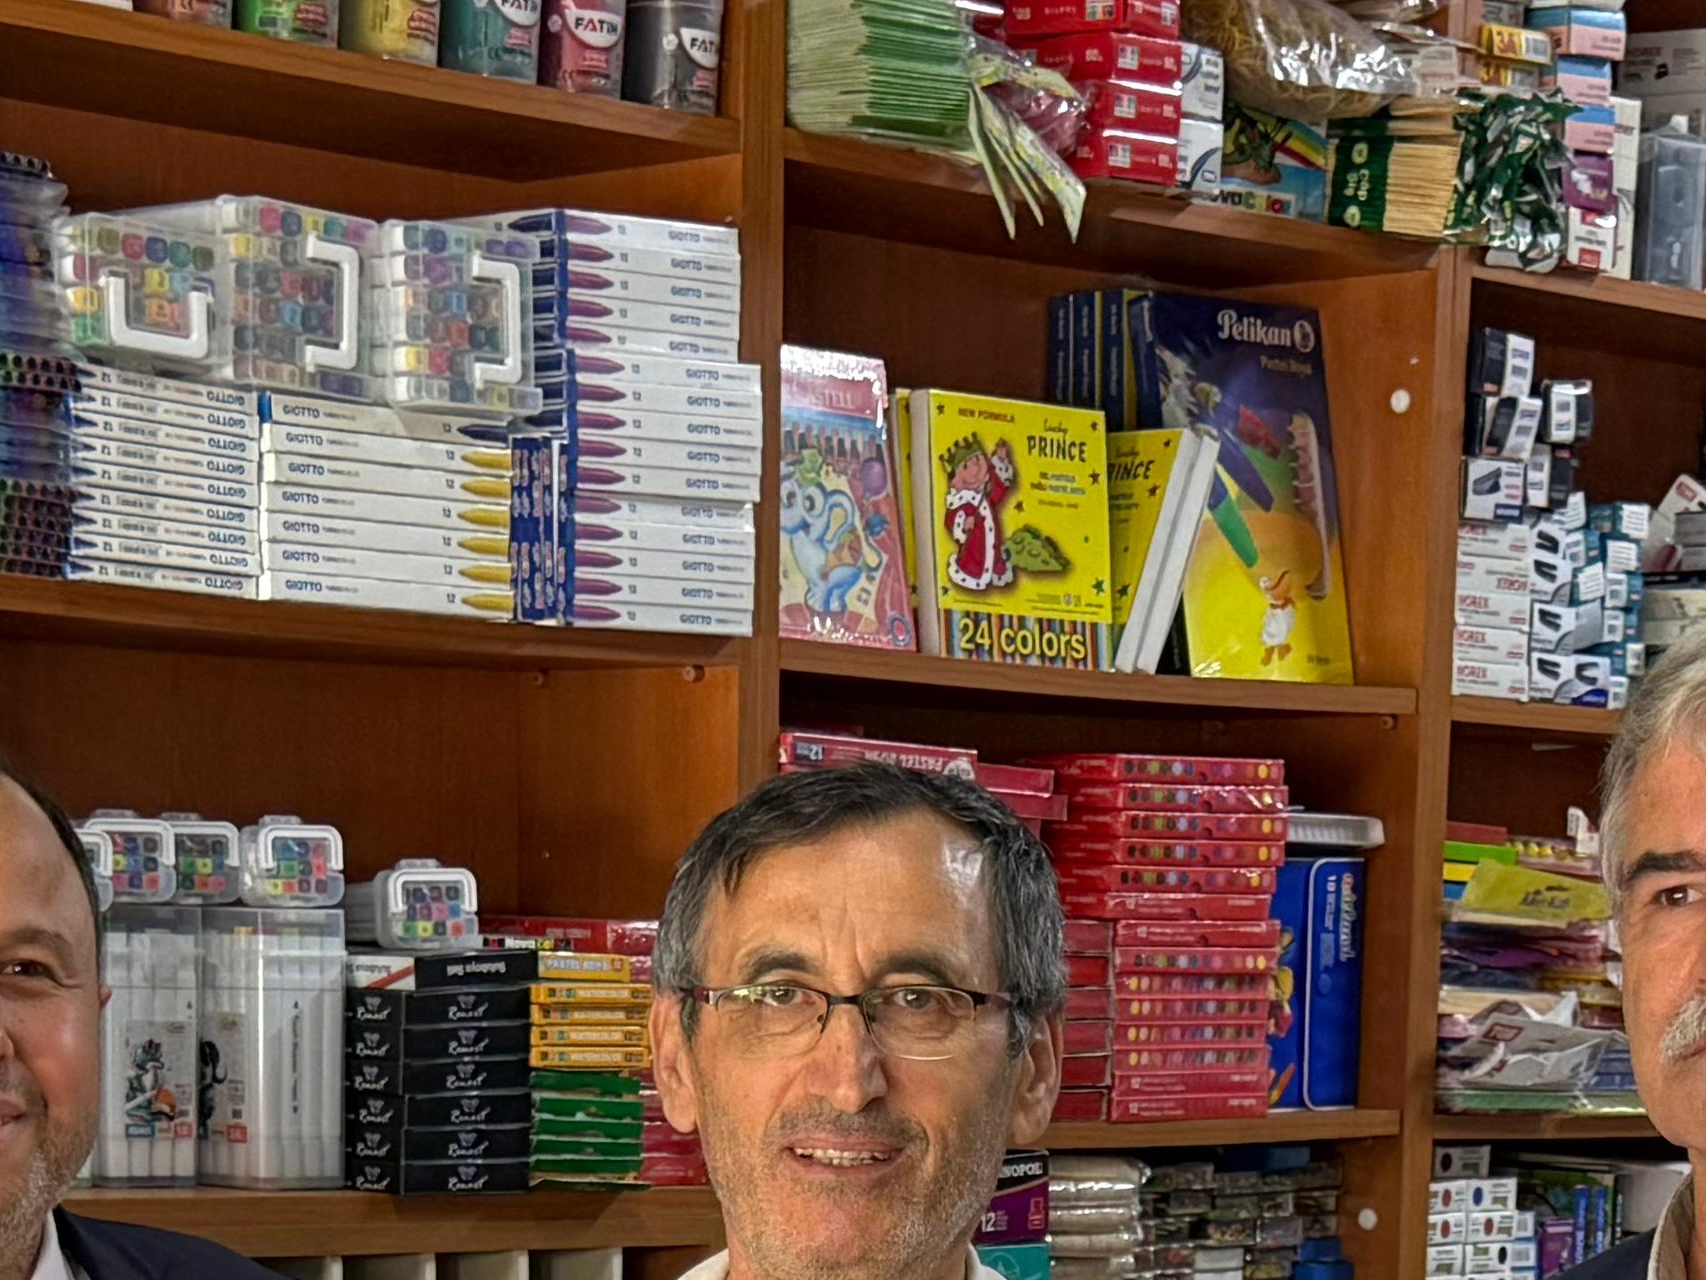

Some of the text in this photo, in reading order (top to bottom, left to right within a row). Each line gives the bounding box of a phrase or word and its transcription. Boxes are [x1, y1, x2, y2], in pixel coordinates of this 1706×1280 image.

[690, 36, 717, 52] FAT
[1217, 309, 1292, 347] Pelikan
[283, 404, 320, 418] GIOTTO
[286, 431, 323, 446] GIOTTO
[1026, 435, 1087, 463] PRINCE
[289, 462, 325, 477] GIOTTO
[282, 490, 319, 505] GIOTTO
[283, 520, 320, 534] GIOTTO
[282, 549, 320, 564] GIOTTO
[286, 579, 323, 593] GIOTTO
[959, 617, 1086, 659] 24 colors
[980, 1212, 995, 1232] 12
